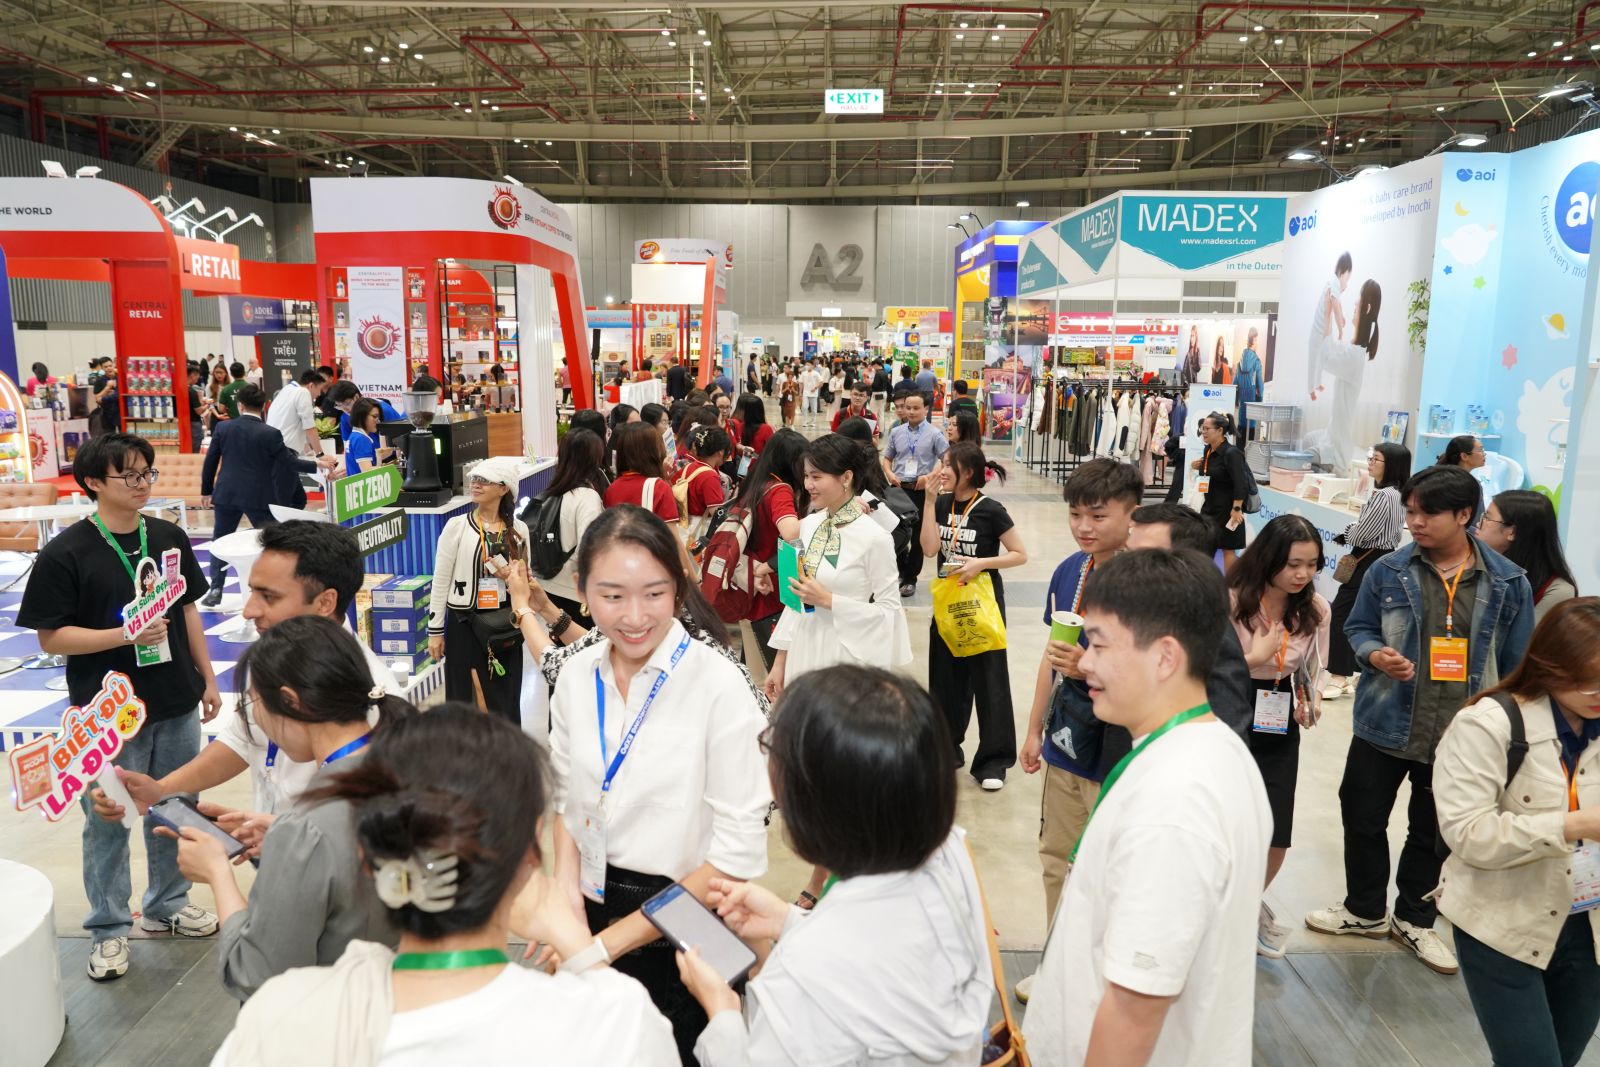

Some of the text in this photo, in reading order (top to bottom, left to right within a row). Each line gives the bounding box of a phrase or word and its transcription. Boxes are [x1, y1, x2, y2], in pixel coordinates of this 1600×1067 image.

[837, 93, 871, 104] EXIT
[1474, 169, 1496, 181] aoi
[1393, 186, 1409, 200] care
[1410, 177, 1433, 195] brand
[14, 207, 53, 215] WORLD
[1138, 203, 1259, 232] MADEX
[1407, 198, 1431, 215] Inochi
[1081, 206, 1116, 243] MADEX
[1300, 209, 1317, 230] aoi
[1180, 237, 1256, 245] www.madexsrl.com
[1540, 195, 1553, 246] Cherish
[1550, 246, 1570, 273] every
[191, 253, 241, 281] RETAIL
[800, 242, 864, 291] A2
[1227, 262, 1235, 270] in
[1237, 262, 1252, 270] the
[122, 301, 168, 310] CENTRAL
[129, 310, 163, 319] RETAIL
[1211, 389, 1222, 397] aoi
[345, 472, 391, 512] NET ZERO
[357, 516, 402, 552] NEUTRALITY
[127, 603, 138, 619] Em
[143, 597, 166, 623] Lung
[165, 578, 185, 603] Linh
[52, 681, 128, 770] BIẾT ĐỦ
[620, 733, 634, 755] EXPO
[46, 727, 119, 815] LÀ ĐỦ
